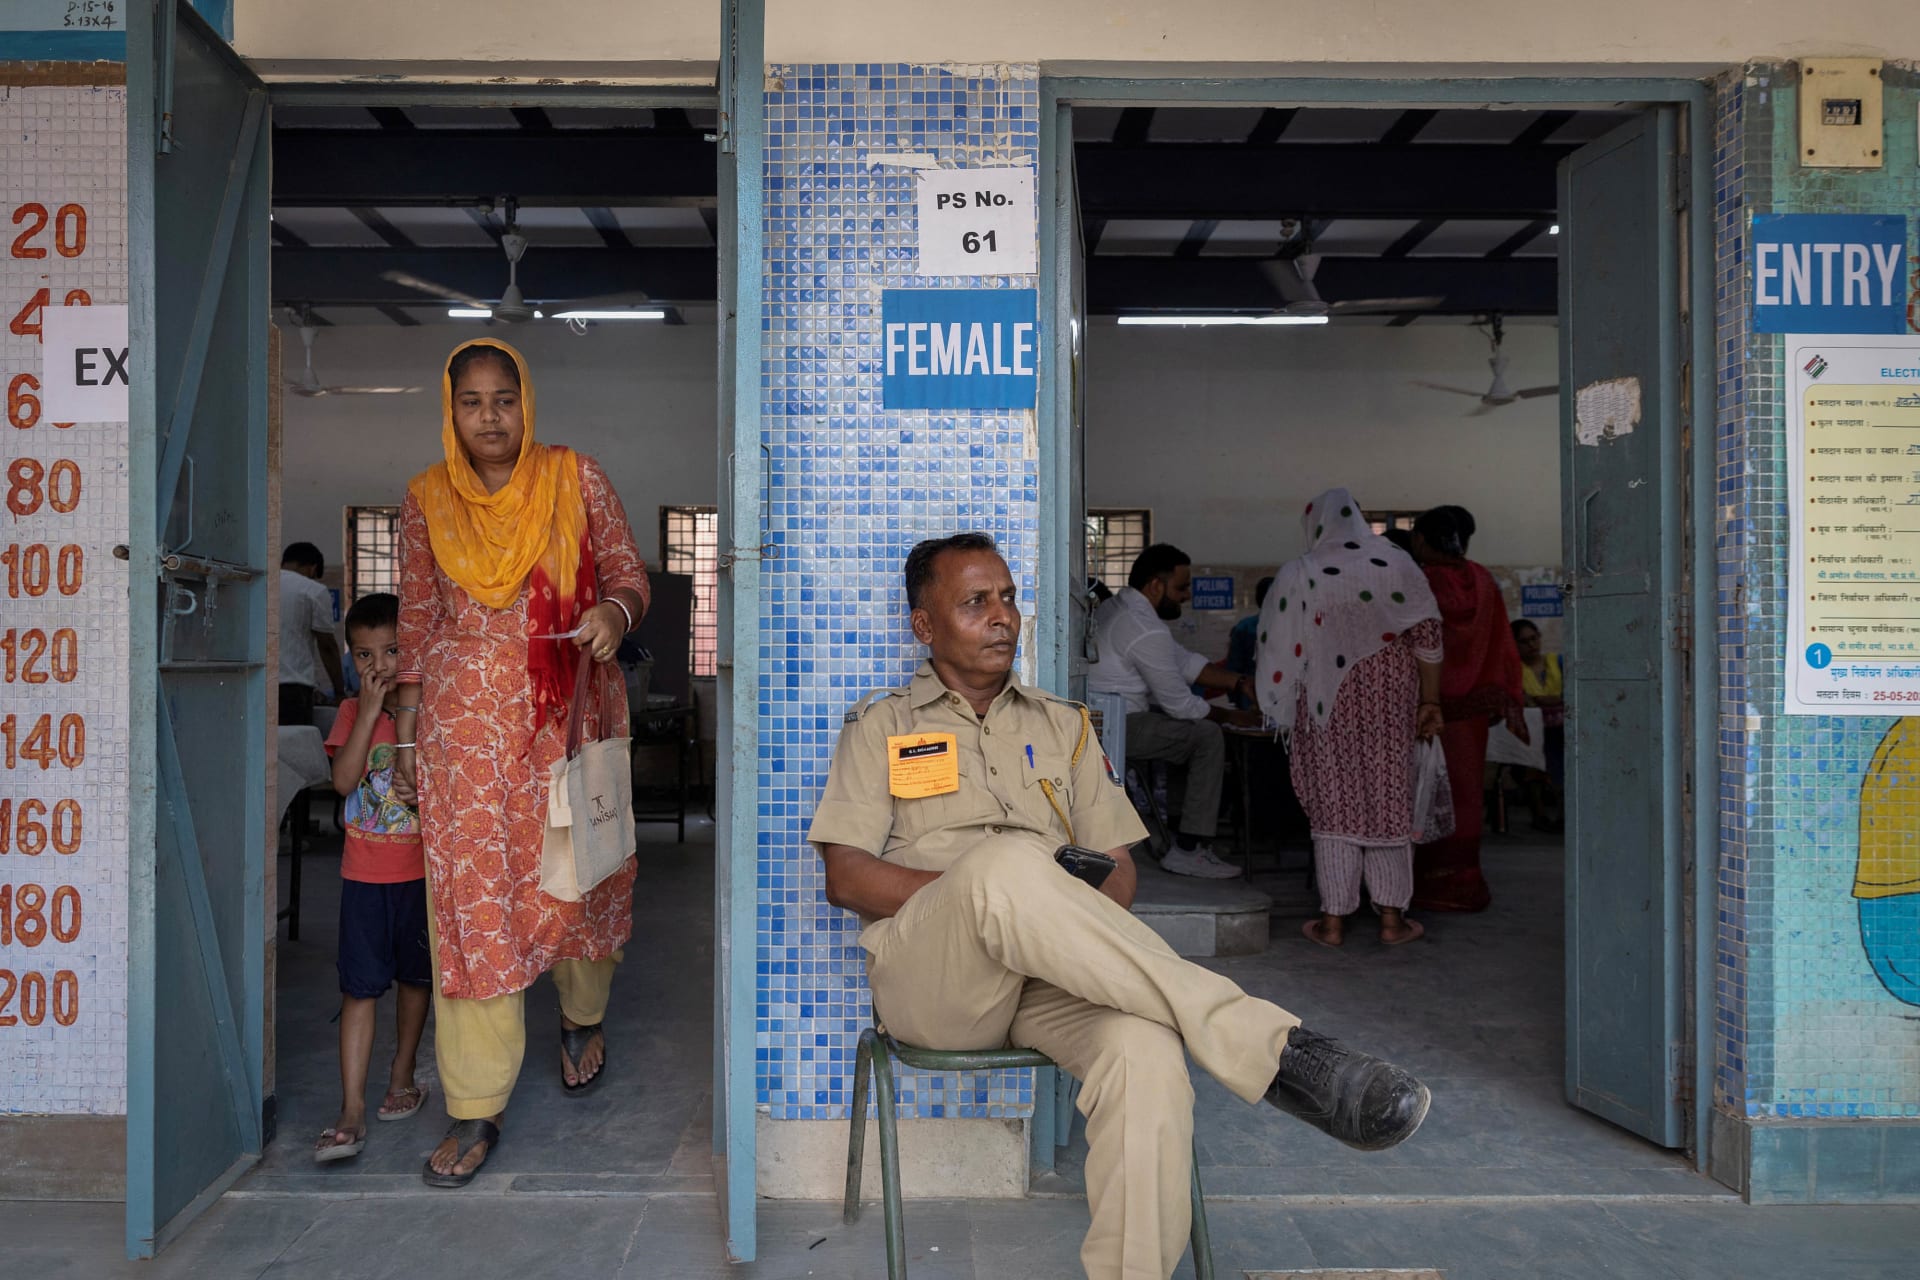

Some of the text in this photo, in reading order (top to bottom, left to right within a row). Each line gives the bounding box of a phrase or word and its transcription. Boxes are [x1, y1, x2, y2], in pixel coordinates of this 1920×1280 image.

[936, 190, 1014, 210] PS No.
[11, 202, 87, 259] 20
[962, 230, 998, 254] 61
[1755, 243, 1902, 306] ENTRY
[886, 322, 1034, 376] FEMALE
[7, 458, 81, 516] 80
[1, 543, 84, 598] 100
[1, 628, 78, 683] 120
[1813, 648, 1822, 665] 1
[1873, 691, 1920, 702] 25-05-20
[1, 713, 86, 770] 140
[0, 798, 82, 856] 160
[0, 884, 82, 947] 180
[0, 969, 79, 1026] 200
